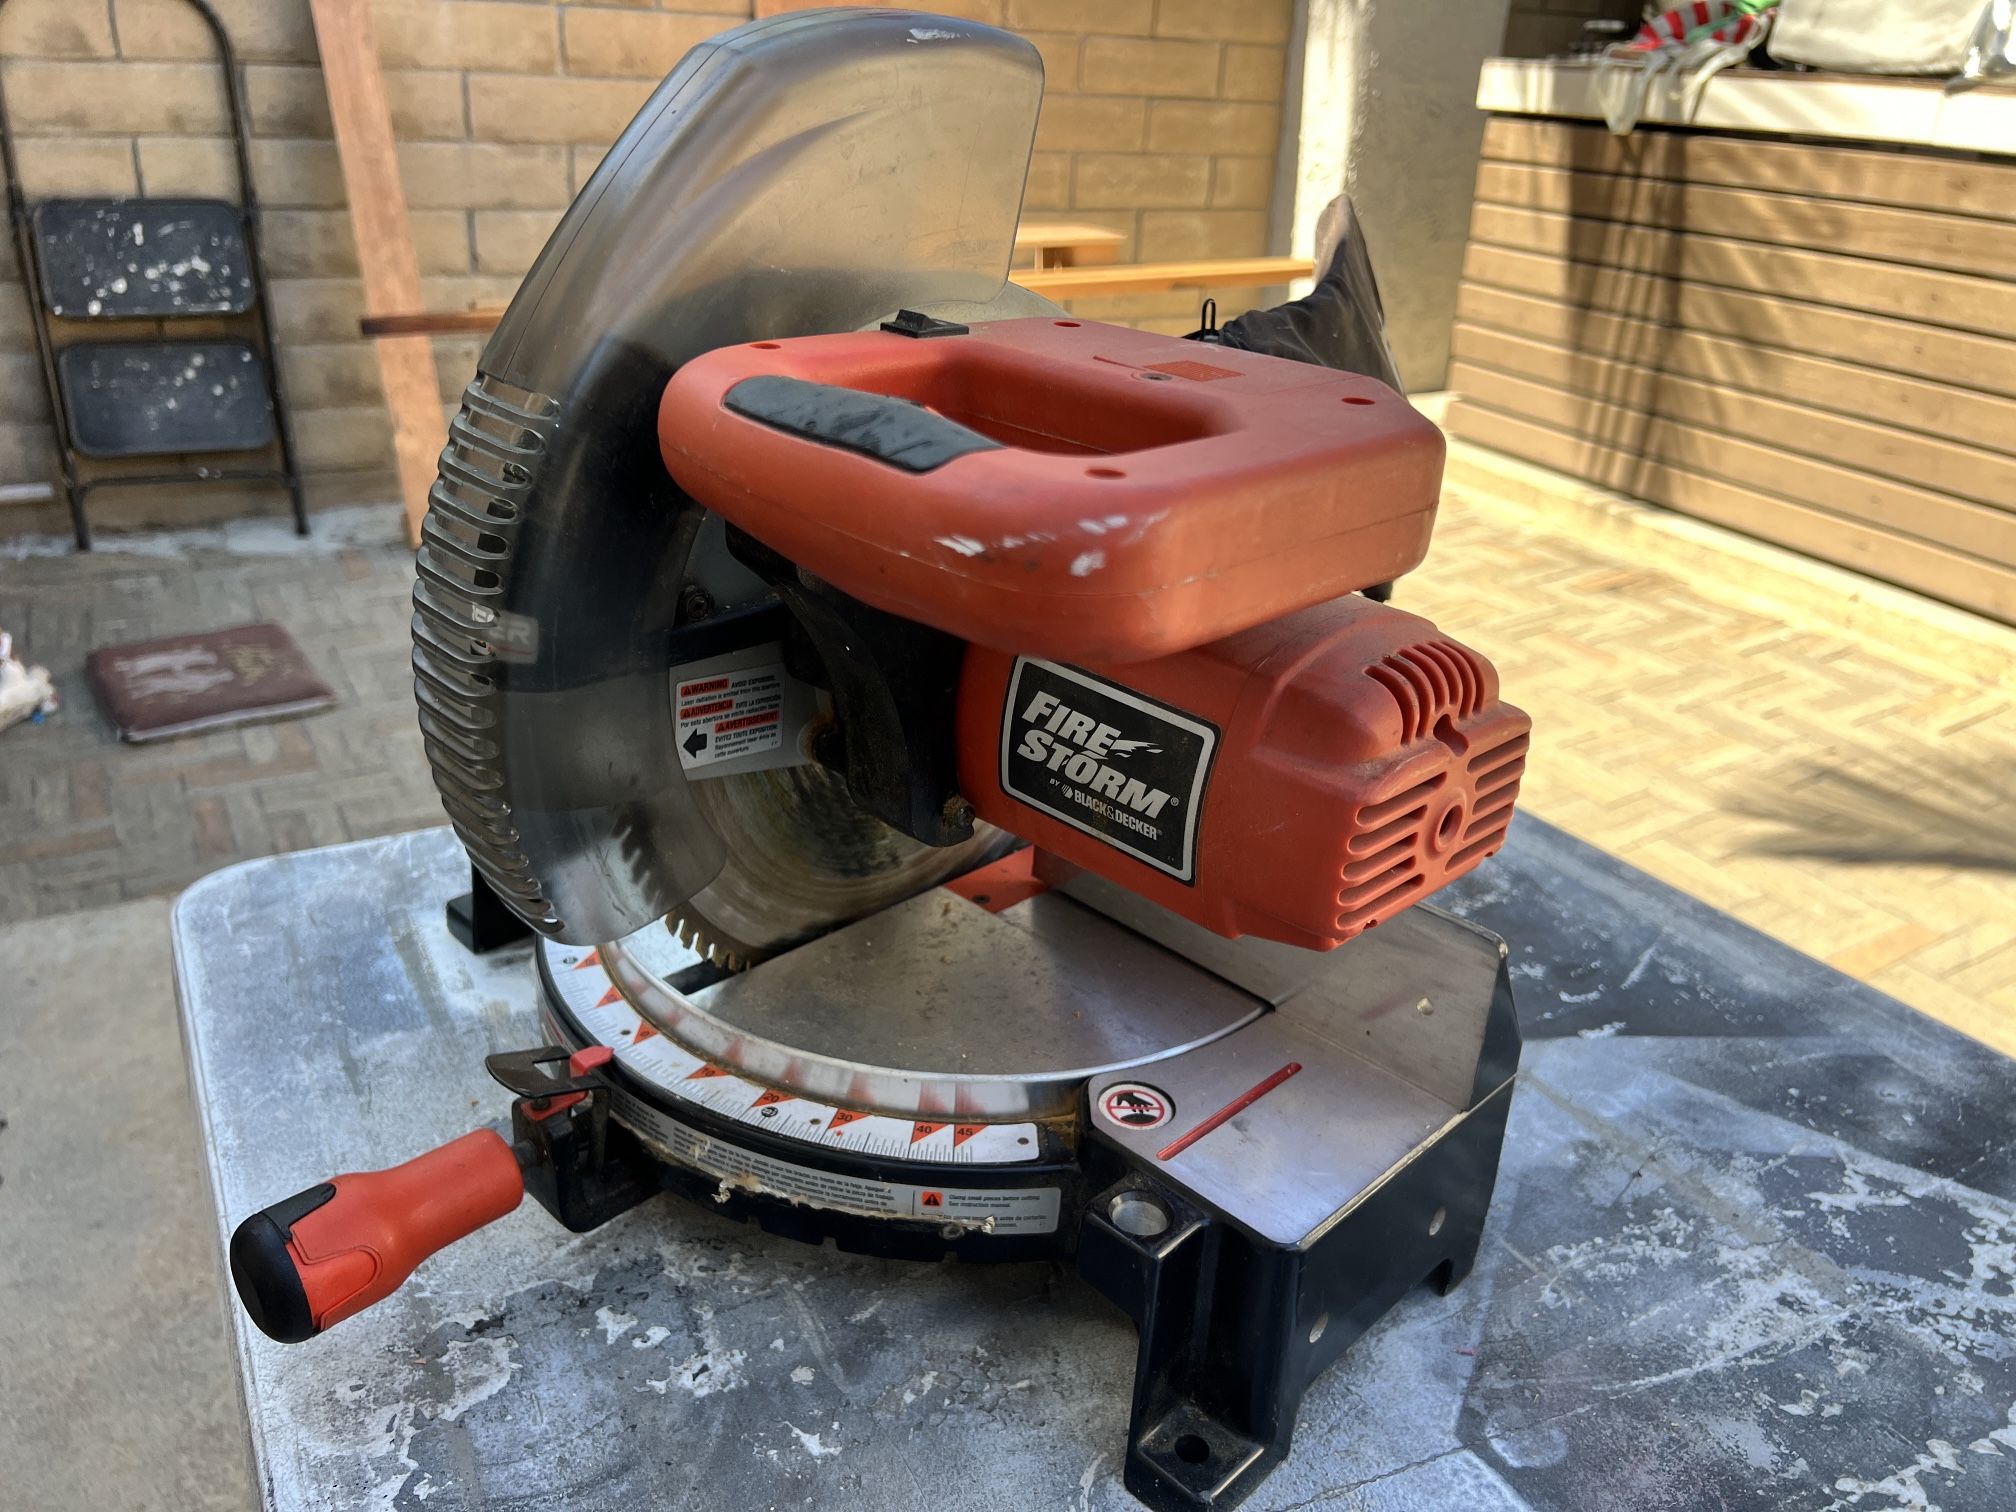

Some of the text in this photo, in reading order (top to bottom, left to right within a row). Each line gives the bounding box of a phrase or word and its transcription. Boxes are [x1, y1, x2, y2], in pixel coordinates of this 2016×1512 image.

[691, 679, 728, 696] WARNING
[731, 680, 747, 688] AVOID
[691, 700, 733, 716] ADVERTENCIA
[725, 710, 779, 730] AVERTISSEMENT
[1022, 690, 1122, 756] FIRE
[733, 730, 748, 739] TOUTE
[727, 747, 749, 756] ouverture
[1049, 778, 1061, 787] BY
[763, 1093, 780, 1103] 20
[837, 1112, 853, 1122] 30
[917, 1125, 932, 1135] 40
[957, 1127, 973, 1136] 45
